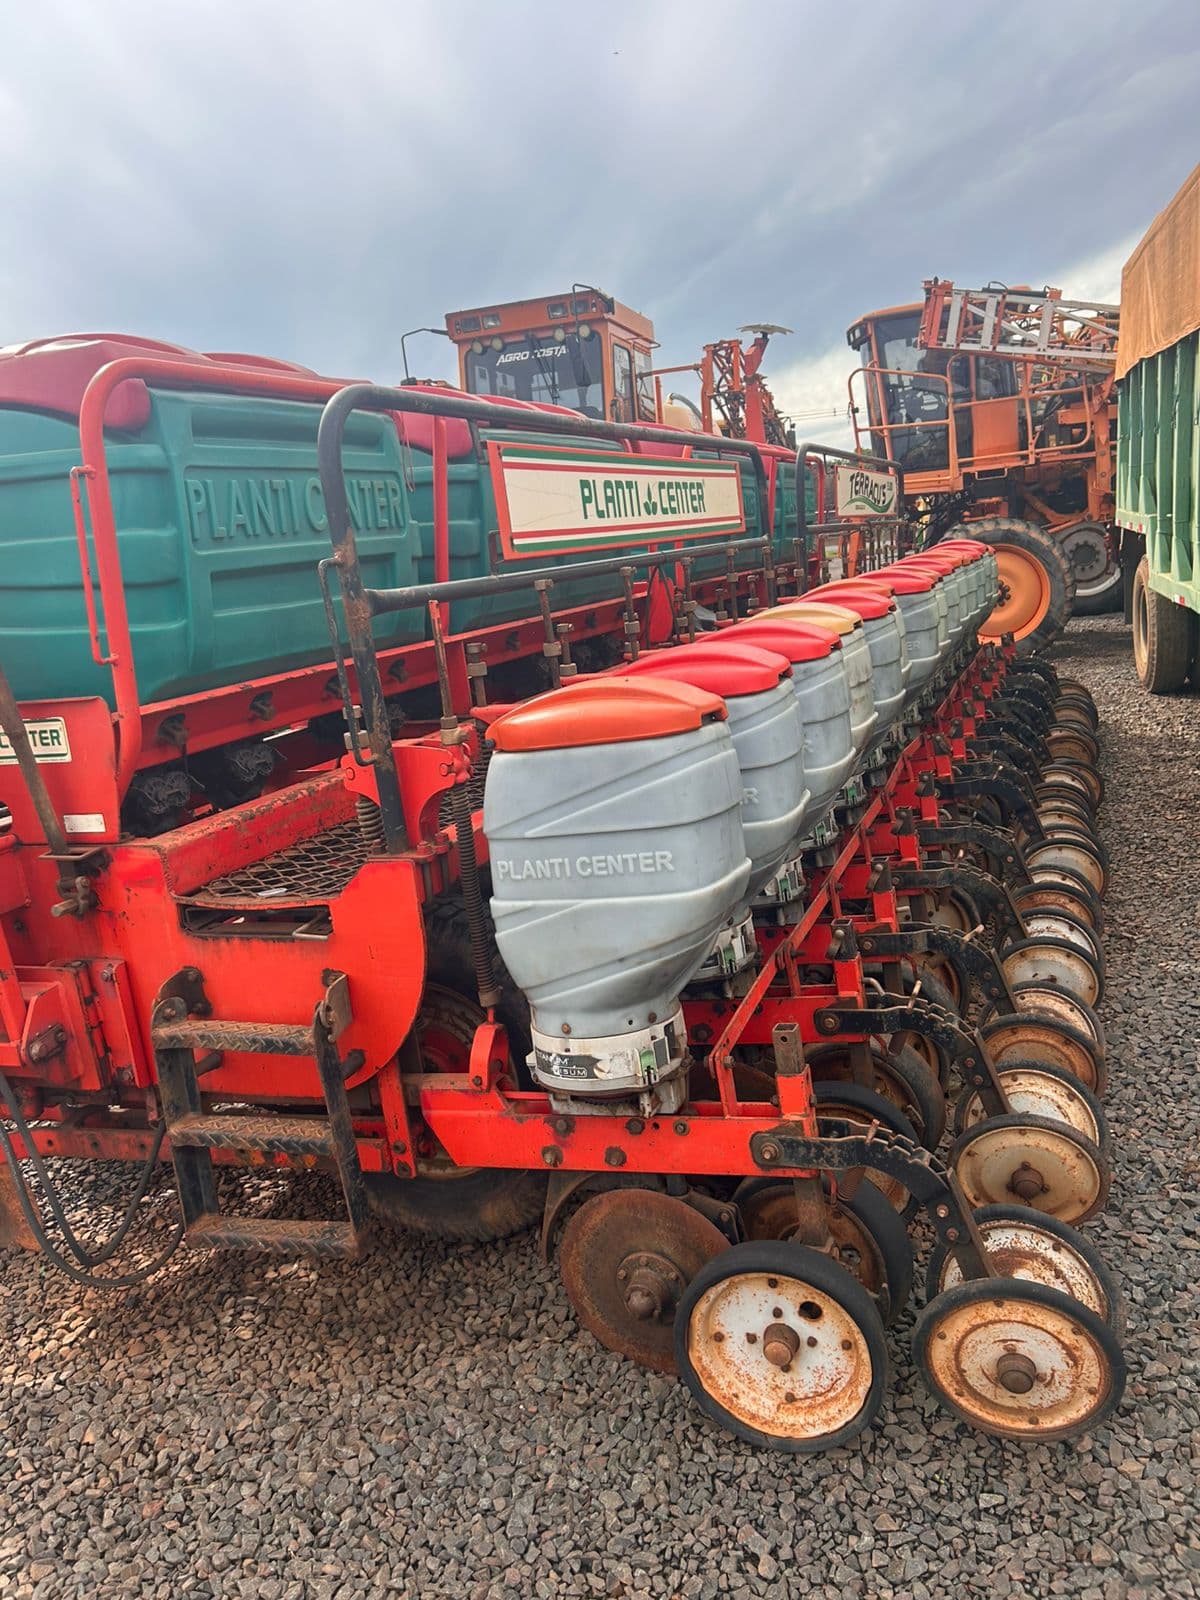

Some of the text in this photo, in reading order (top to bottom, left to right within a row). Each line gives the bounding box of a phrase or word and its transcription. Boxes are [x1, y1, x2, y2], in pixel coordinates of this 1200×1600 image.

[496, 351, 529, 367] AGRO
[184, 476, 407, 542] PLANTI CNTER
[579, 479, 642, 520] PLANTI
[658, 480, 706, 516] CENTER
[0, 729, 62, 748] CTER
[497, 851, 676, 881] PLANTI CENTER
